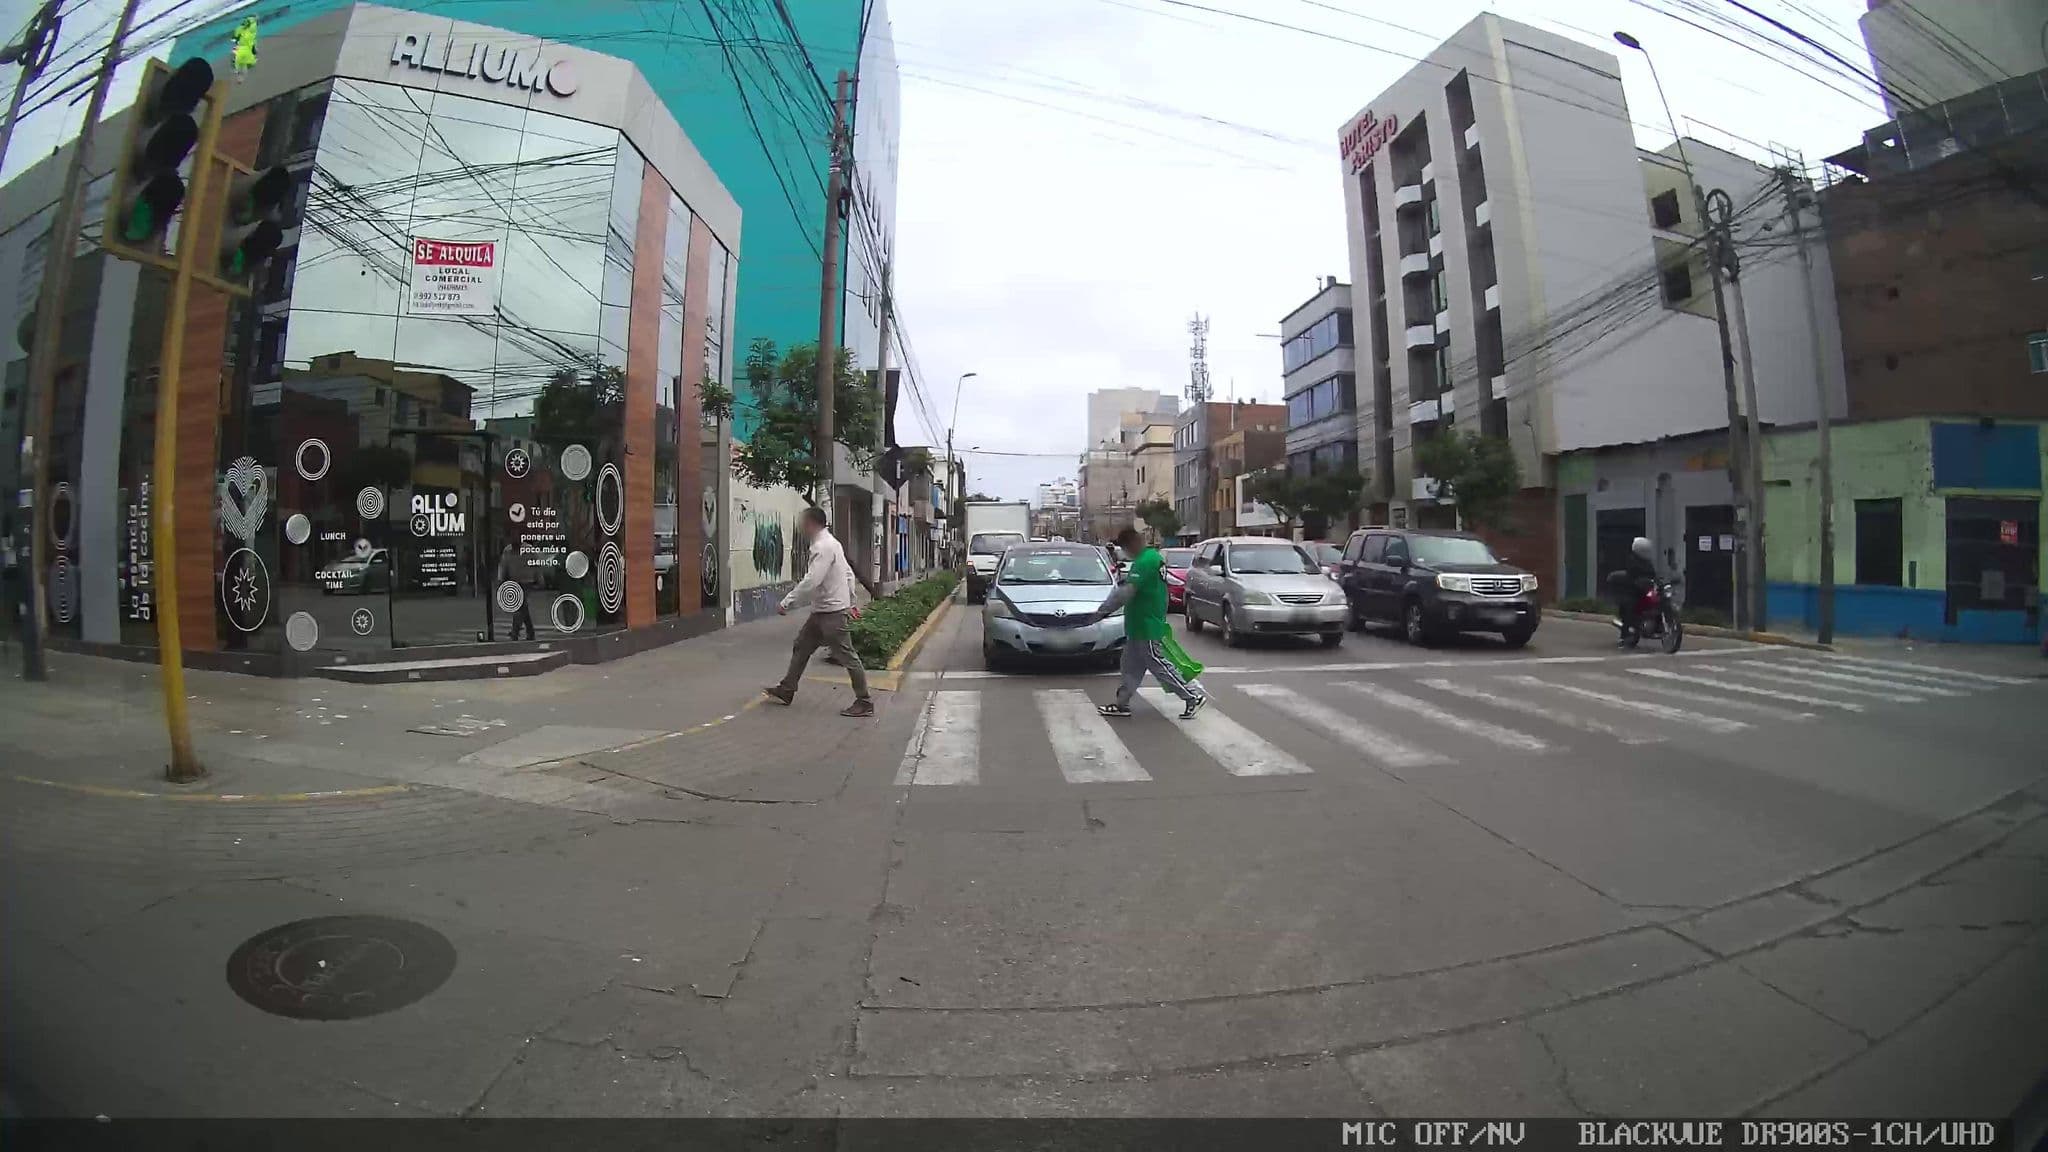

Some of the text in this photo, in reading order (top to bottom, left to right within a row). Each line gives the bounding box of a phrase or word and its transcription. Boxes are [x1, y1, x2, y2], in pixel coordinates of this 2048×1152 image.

[417, 243, 492, 263] SE ALQUILA
[438, 267, 470, 275] LOCAL
[425, 275, 483, 283] COMERCIAL
[543, 507, 556, 516] día
[526, 519, 560, 531] está por
[320, 531, 346, 541] LUNCH
[520, 534, 554, 543] ponerse
[519, 547, 541, 556] poco
[542, 544, 559, 553] más
[138, 564, 149, 584] la
[314, 570, 354, 580] COCKTAIL
[325, 580, 344, 590] TIME
[129, 595, 140, 618] La
[139, 592, 151, 620] de
